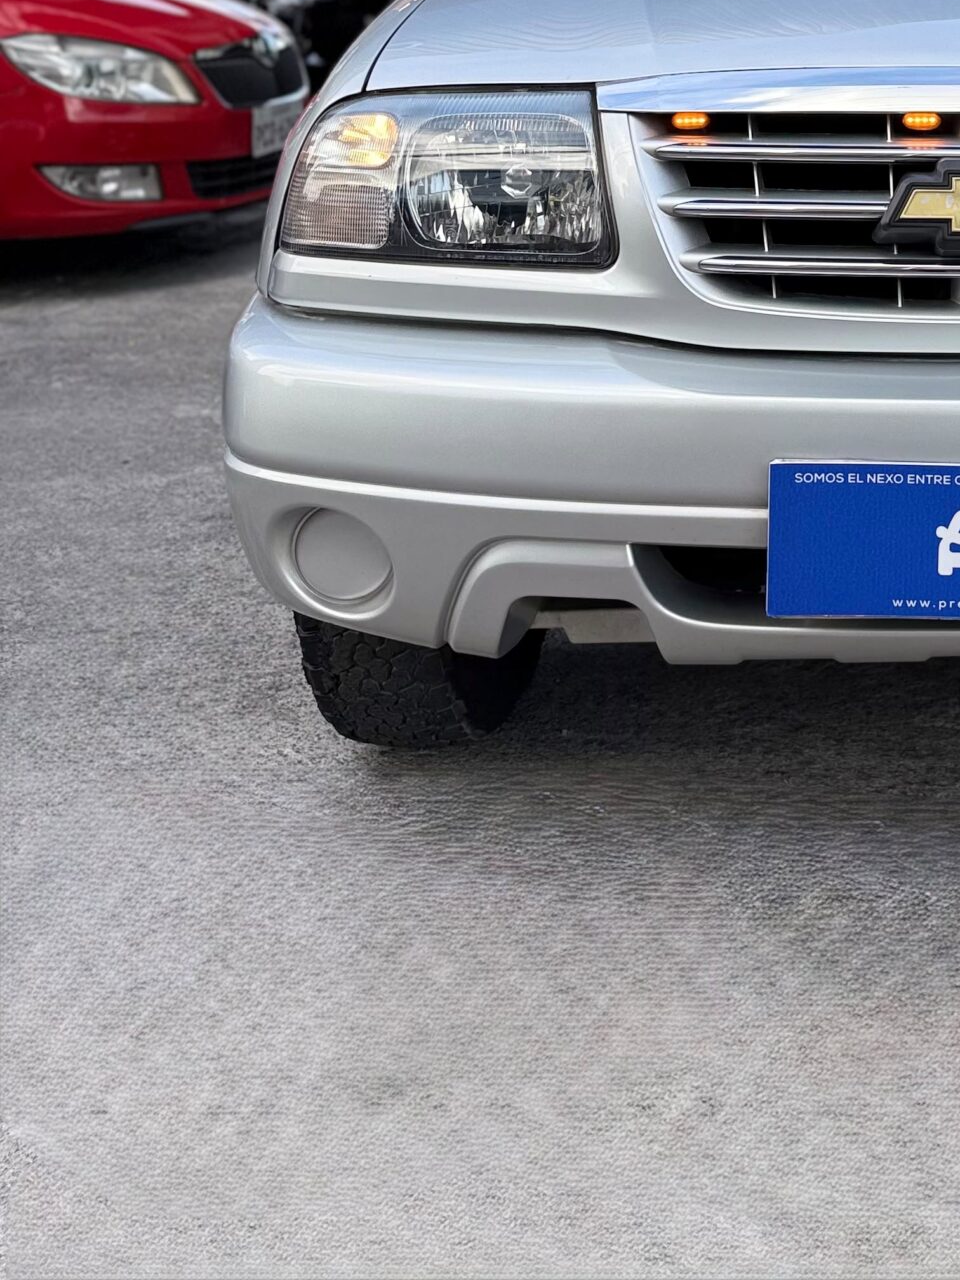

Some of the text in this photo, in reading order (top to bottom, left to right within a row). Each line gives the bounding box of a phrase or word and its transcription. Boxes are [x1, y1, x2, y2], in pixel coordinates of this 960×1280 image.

[794, 472, 845, 484] SOMOS
[847, 472, 865, 484] EL
[866, 473, 904, 485] NEXO
[906, 474, 952, 485] ENTRE
